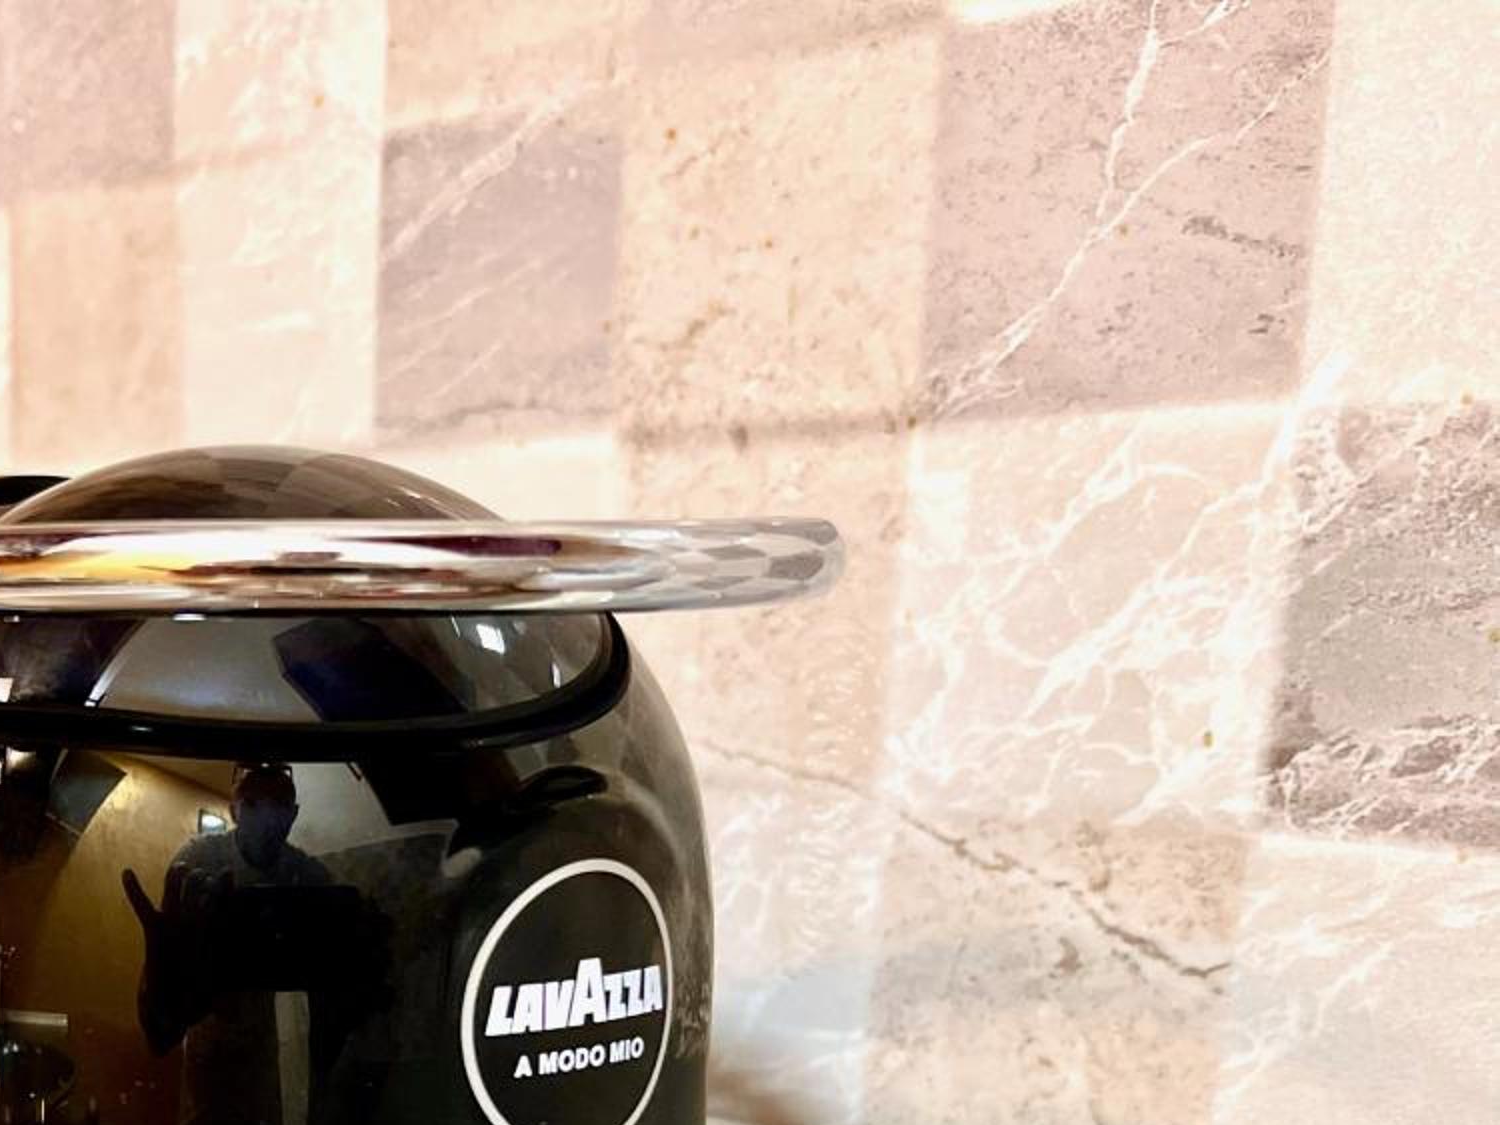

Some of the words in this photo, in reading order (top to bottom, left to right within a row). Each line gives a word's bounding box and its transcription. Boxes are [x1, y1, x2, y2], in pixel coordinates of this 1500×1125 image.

[484, 957, 664, 1037] LAVAZZA
[513, 1055, 533, 1079] A
[538, 1045, 606, 1076] MODO
[609, 1036, 645, 1063] MIO
